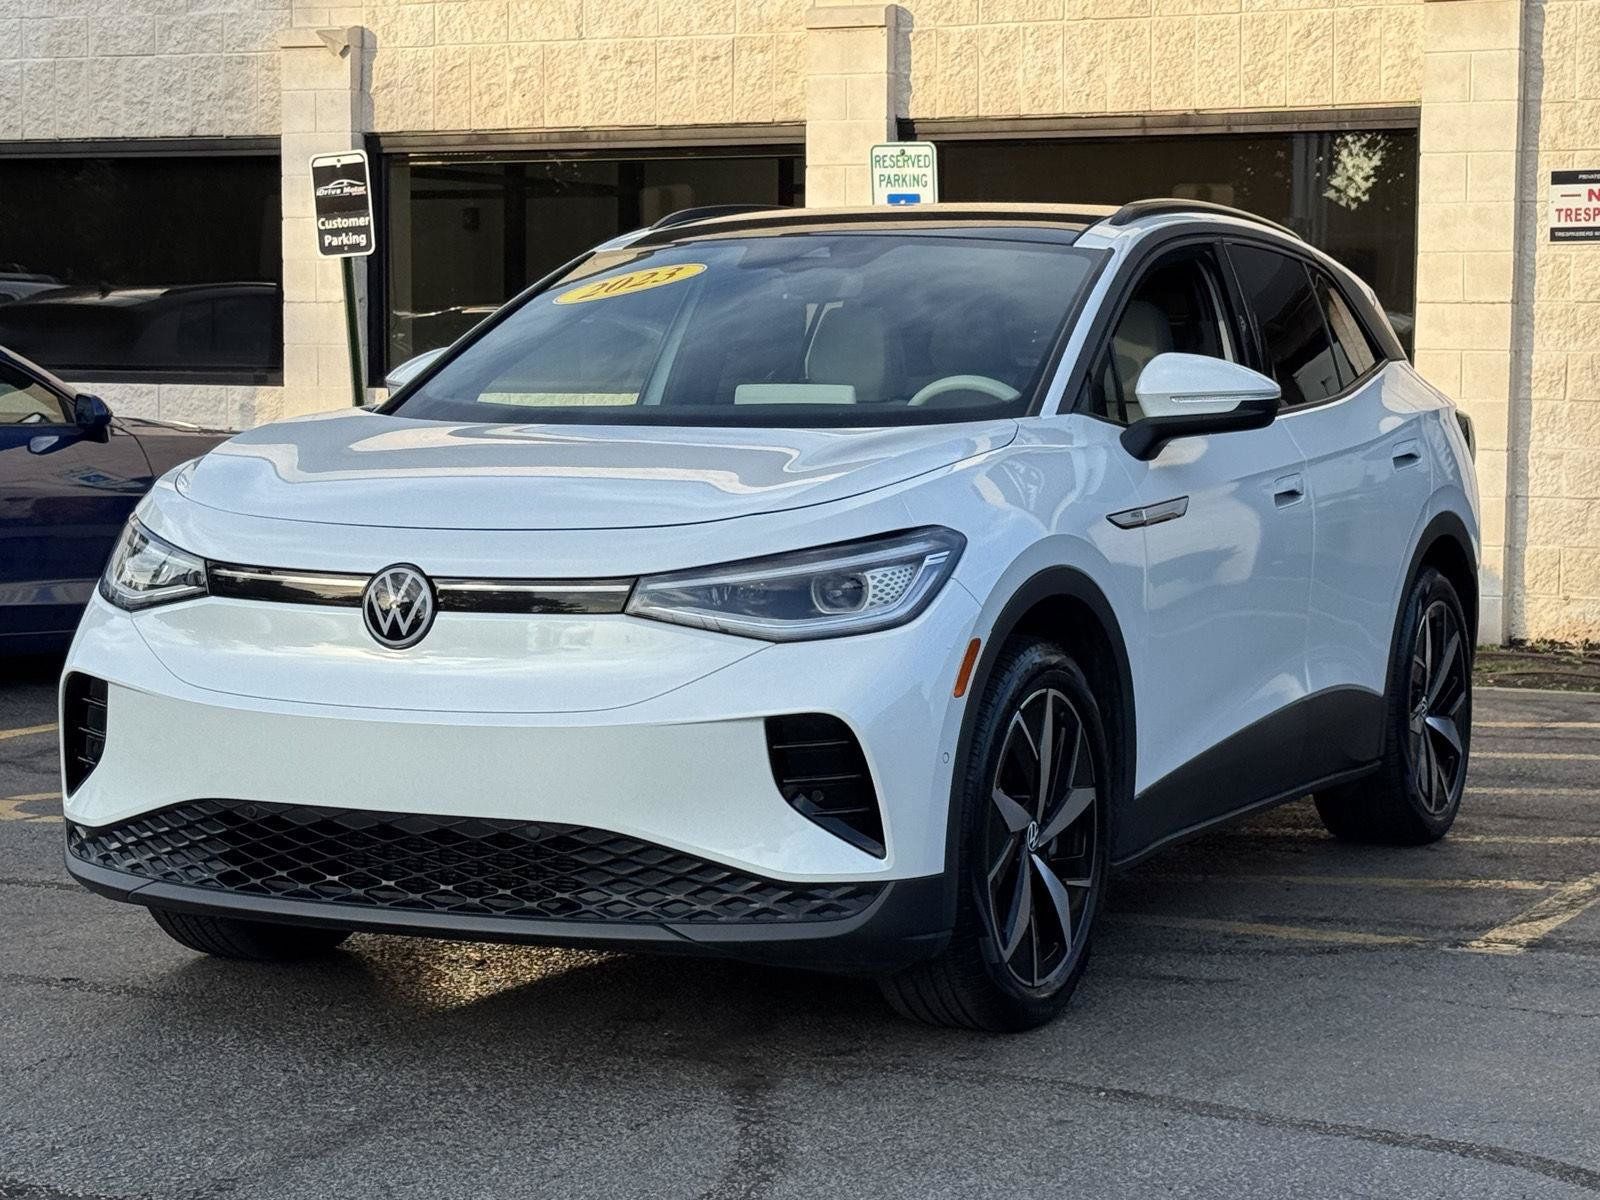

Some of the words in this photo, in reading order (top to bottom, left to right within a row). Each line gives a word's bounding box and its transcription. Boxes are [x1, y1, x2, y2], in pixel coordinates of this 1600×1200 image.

[874, 154, 931, 169] RESERVED
[879, 174, 928, 188] PARKING
[318, 216, 370, 229] Customer
[324, 231, 367, 248] Parking
[576, 266, 685, 300] 2023
[364, 567, 433, 645] VW
